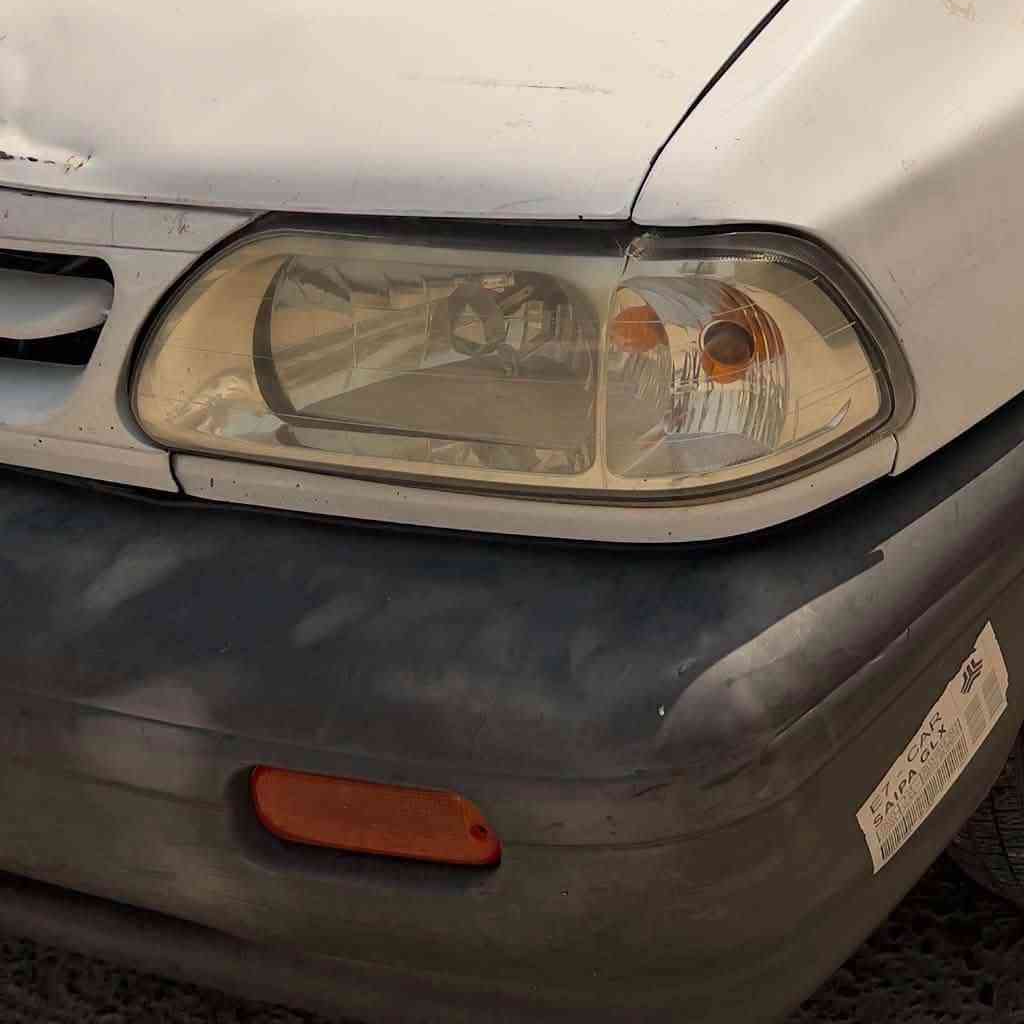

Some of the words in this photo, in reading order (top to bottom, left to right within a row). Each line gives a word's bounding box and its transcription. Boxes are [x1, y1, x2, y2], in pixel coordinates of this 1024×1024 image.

[873, 768, 917, 828] SAIPA
[920, 723, 947, 764] GLX
[906, 711, 942, 763] CAR
